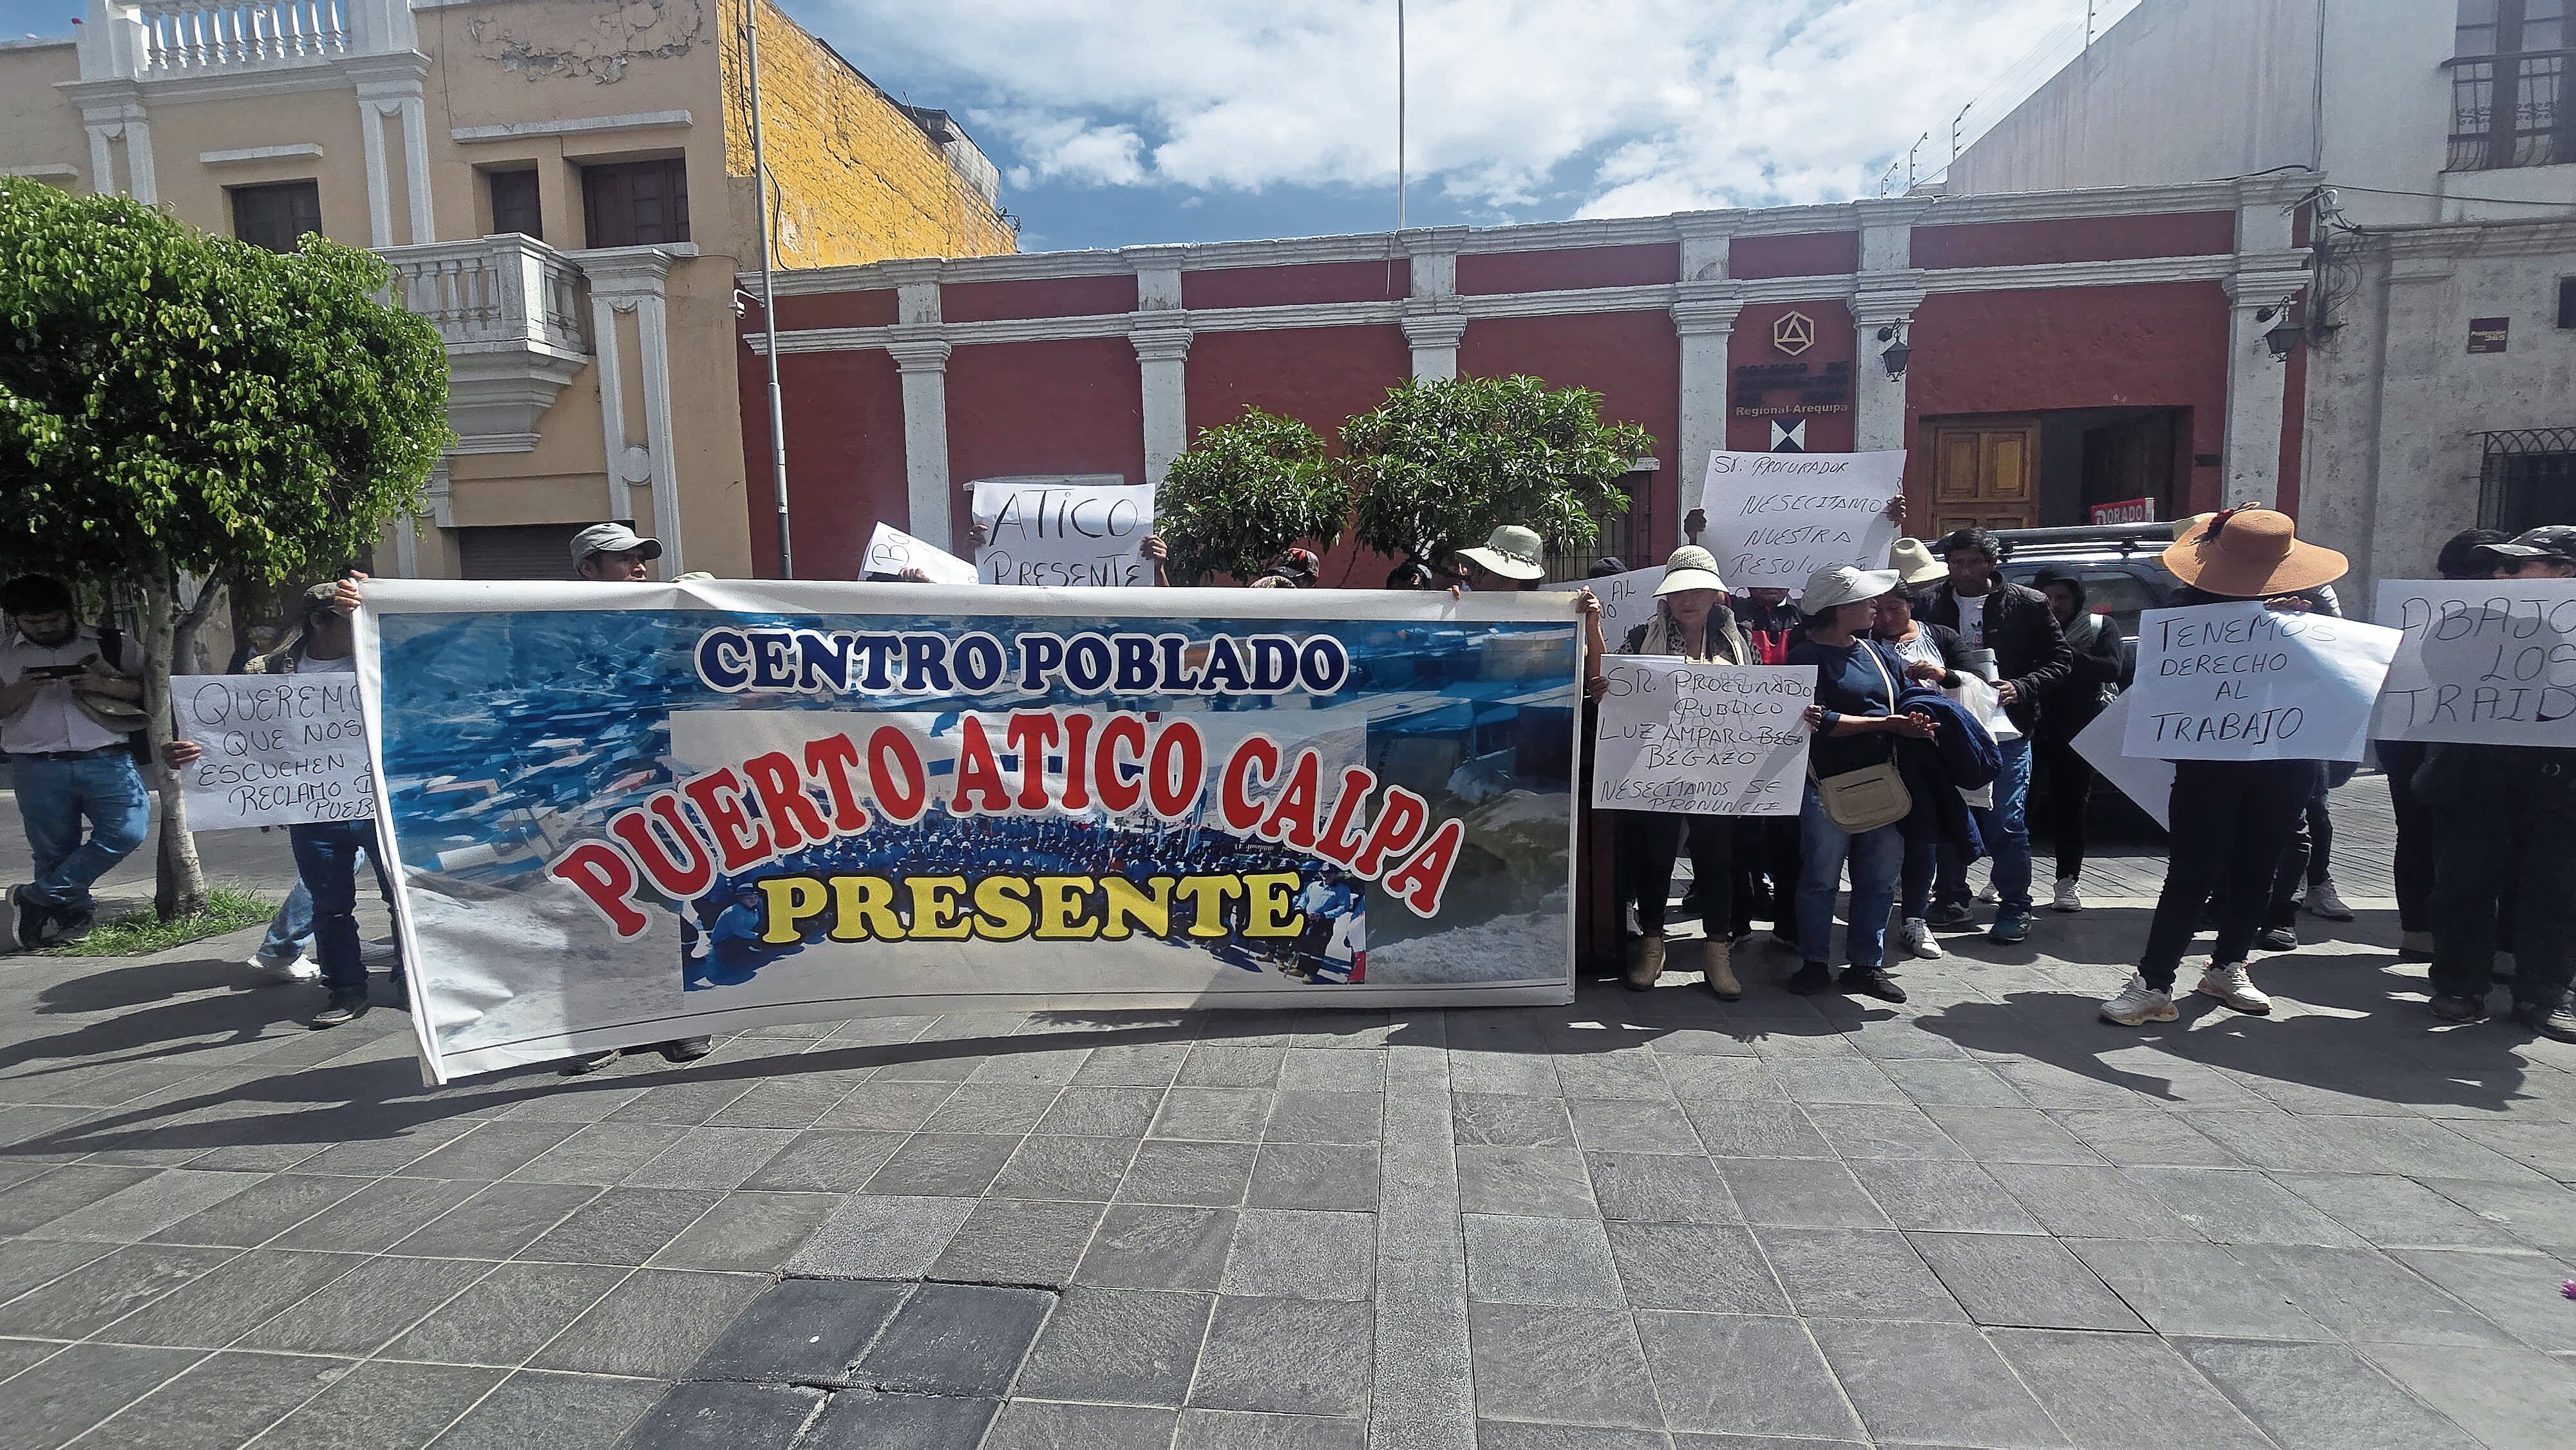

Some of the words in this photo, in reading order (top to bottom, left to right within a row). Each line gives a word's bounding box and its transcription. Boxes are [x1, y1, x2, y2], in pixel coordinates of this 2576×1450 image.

[1736, 405, 1789, 417] Regional
[1792, 402, 1850, 415] Arequipa
[1743, 525, 1852, 547] NUESTRA
[983, 550, 1141, 587] PRESENTE
[2156, 614, 2337, 653] TENEMOS
[694, 626, 1009, 695] CENTRO
[1015, 631, 1349, 695] POBLADO
[2159, 652, 2288, 677] DERECHO
[2215, 679, 2249, 702] AL
[223, 729, 285, 757] QUE
[304, 719, 362, 745] NOS
[1598, 716, 1657, 740] LUZ
[2151, 708, 2304, 745] TRABAJO
[198, 753, 345, 787] ESCUCHEN
[1744, 779, 1783, 795] SE
[228, 781, 342, 816] RECLAMO
[546, 720, 933, 943] PUERTO
[947, 708, 1211, 822] ATICO
[1218, 731, 1465, 919] CALPA
[756, 871, 1305, 944] PRESENTE
